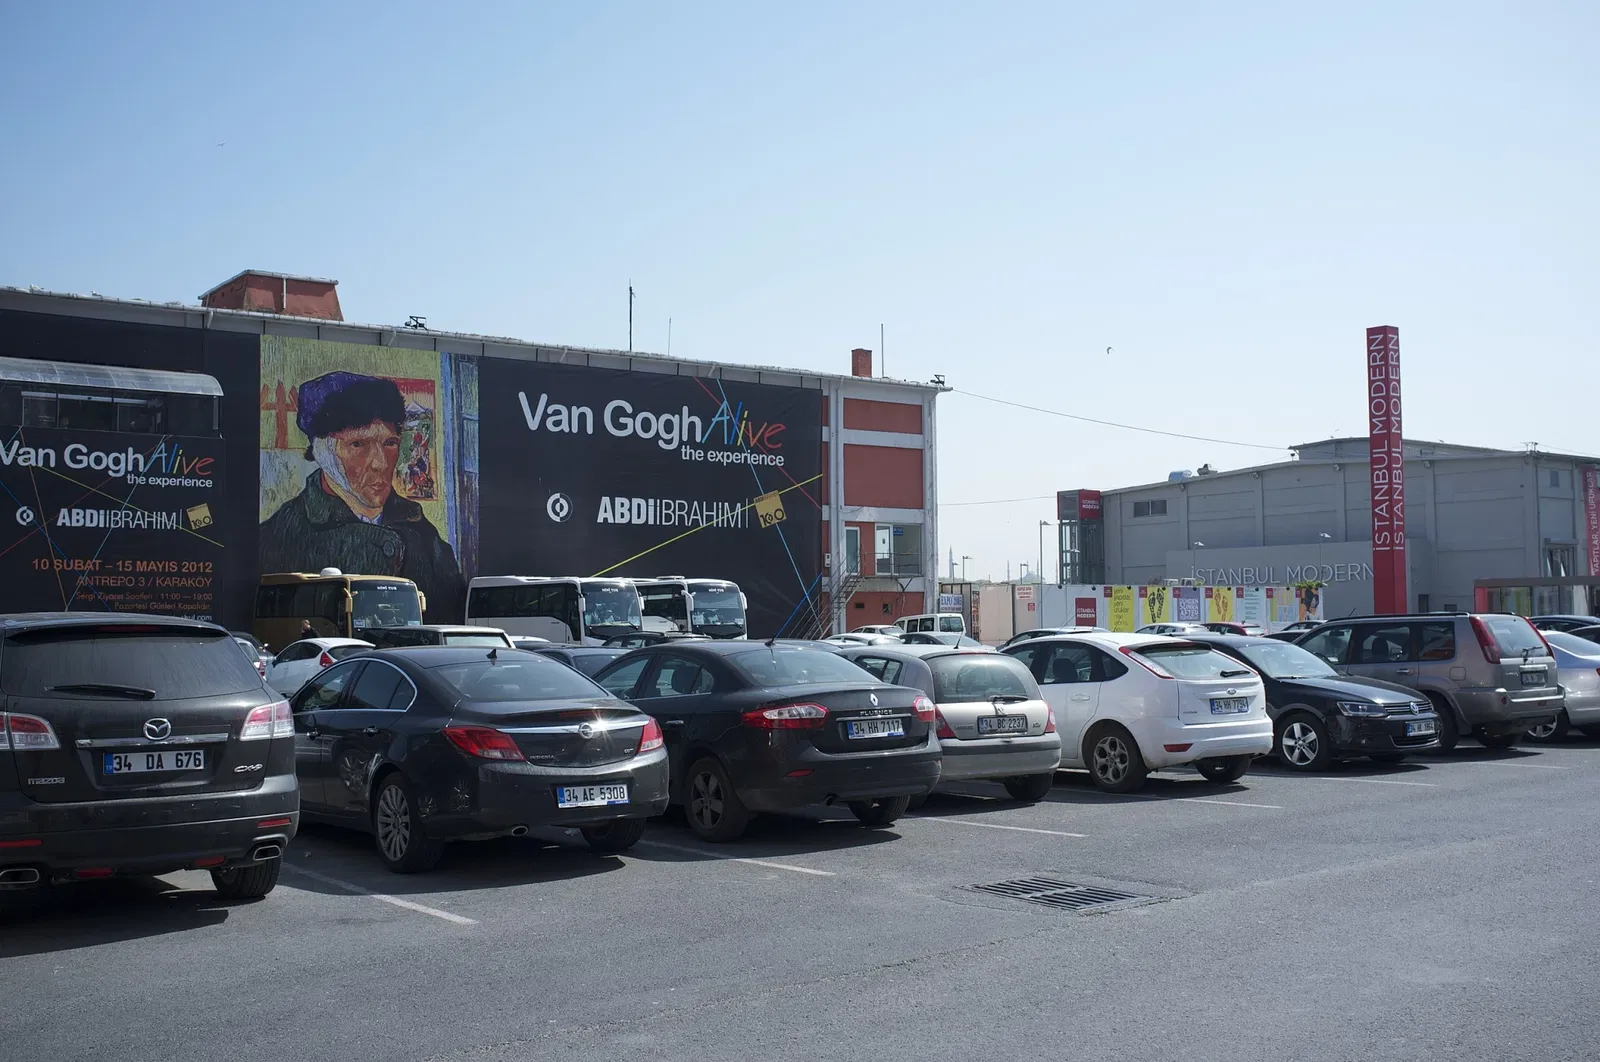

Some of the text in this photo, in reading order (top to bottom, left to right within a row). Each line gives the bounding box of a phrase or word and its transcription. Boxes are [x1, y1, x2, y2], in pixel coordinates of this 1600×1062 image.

[1369, 334, 1387, 434] MODERN
[1388, 334, 1402, 433] MODERN
[518, 391, 786, 450] Van Gogh Alive
[0, 440, 56, 468] Van
[63, 443, 145, 478] Gogh
[681, 445, 785, 467] the experience
[127, 473, 213, 488] the experience
[32, 558, 49, 570] 10
[116, 560, 132, 572] 15
[136, 560, 178, 573] MAYIS
[181, 561, 213, 573] 2012
[1286, 562, 1375, 584] MODERN
[76, 576, 135, 587] ANTREPO
[138, 576, 145, 587] 3
[854, 722, 865, 735] 34
[868, 721, 879, 734] HH
[984, 718, 993, 729] 34
[1008, 717, 1025, 729] 2237
[113, 752, 202, 771] 34 DA 676
[565, 786, 625, 802] 34 AE 5308
